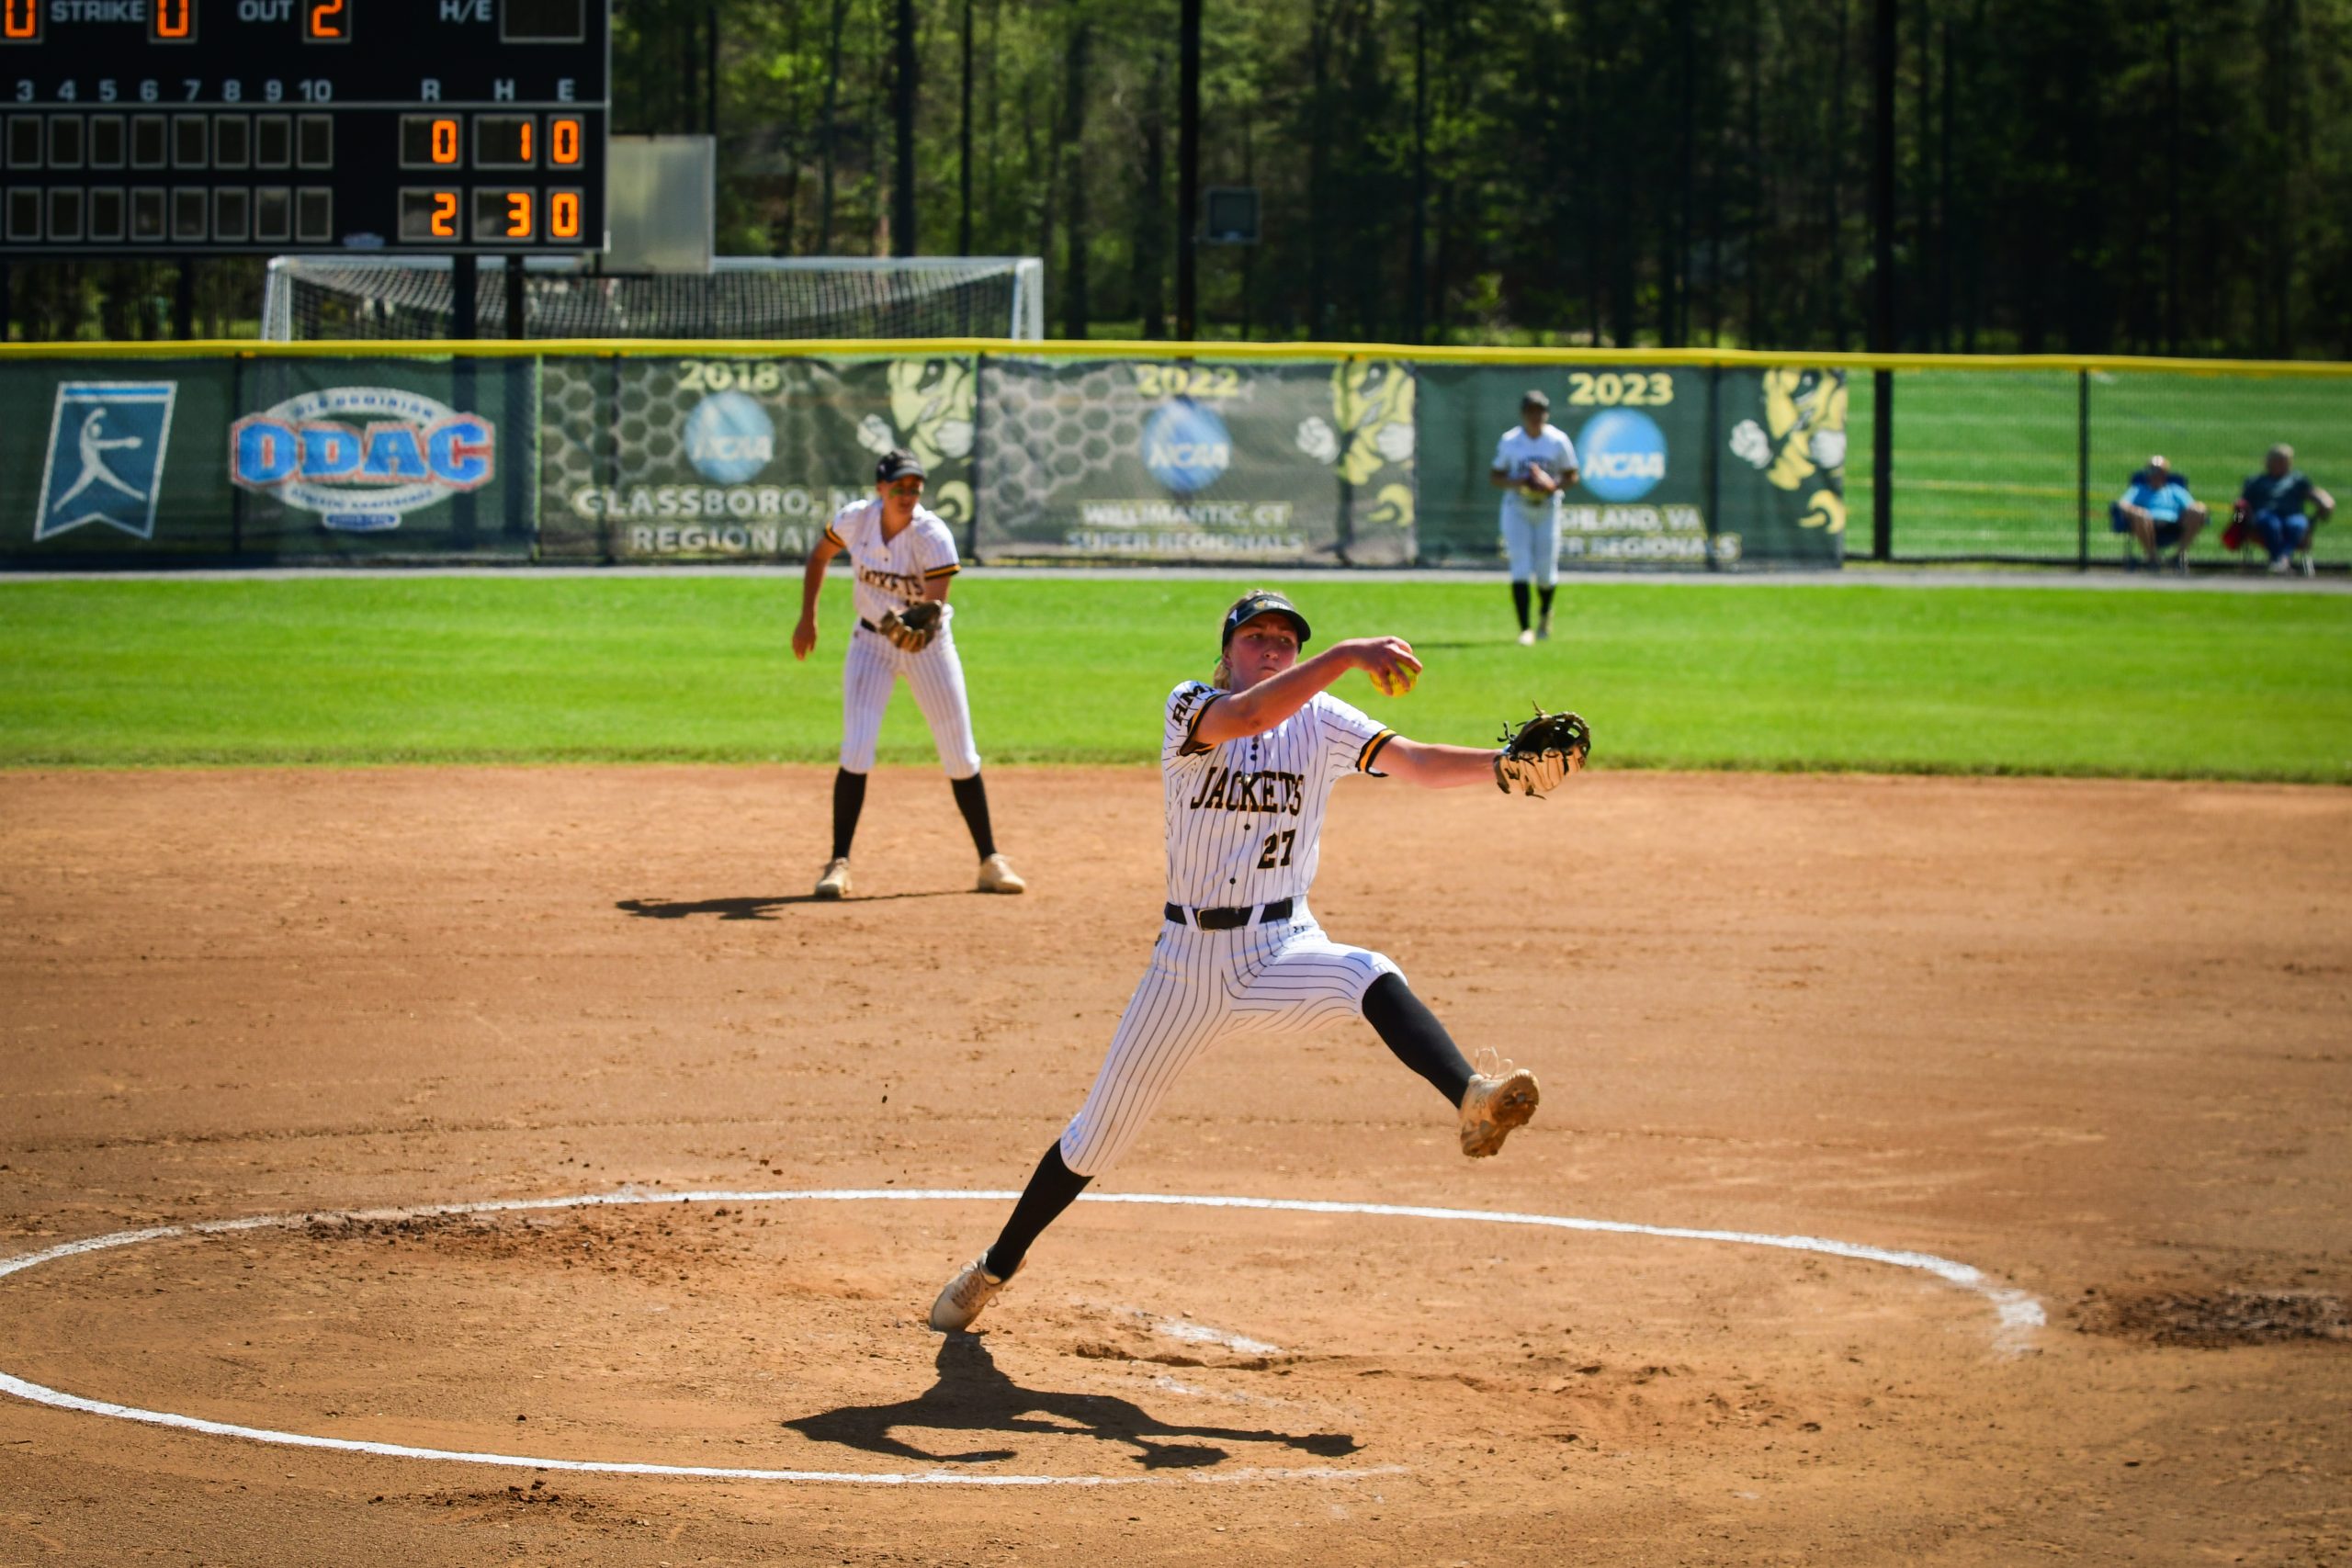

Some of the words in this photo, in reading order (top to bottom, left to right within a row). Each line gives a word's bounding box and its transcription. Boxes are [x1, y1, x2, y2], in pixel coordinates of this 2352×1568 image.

[51, 0, 145, 22] STRIKE
[239, 0, 293, 22] OUT
[311, 0, 344, 37] 2
[440, 0, 492, 24] H/E
[17, 80, 34, 102] 3
[58, 80, 76, 102] 4
[99, 80, 117, 102] 5
[140, 80, 159, 102] 6
[183, 80, 200, 102] 7
[223, 80, 241, 102] 8
[266, 80, 282, 102] 9
[299, 80, 332, 102] 10
[421, 78, 441, 101] R
[493, 78, 514, 101] H
[557, 78, 575, 102] E
[432, 120, 457, 164] 0
[553, 120, 579, 164] 0
[431, 193, 456, 236] 2
[507, 193, 531, 237] 3
[552, 193, 579, 237] 0
[678, 360, 780, 392] 2018
[1136, 365, 1239, 396] 2022
[1566, 372, 1674, 406] 2023
[232, 412, 495, 491] ODAC
[1148, 443, 1231, 470] NCAA
[1582, 452, 1668, 480] NCAA
[573, 486, 826, 520] GLASSBORO,
[1252, 502, 1290, 528] CT
[1666, 506, 1701, 531] VA
[1172, 685, 1215, 726] RM
[1190, 766, 1305, 817] JACKETS
[1257, 829, 1296, 869] 27
